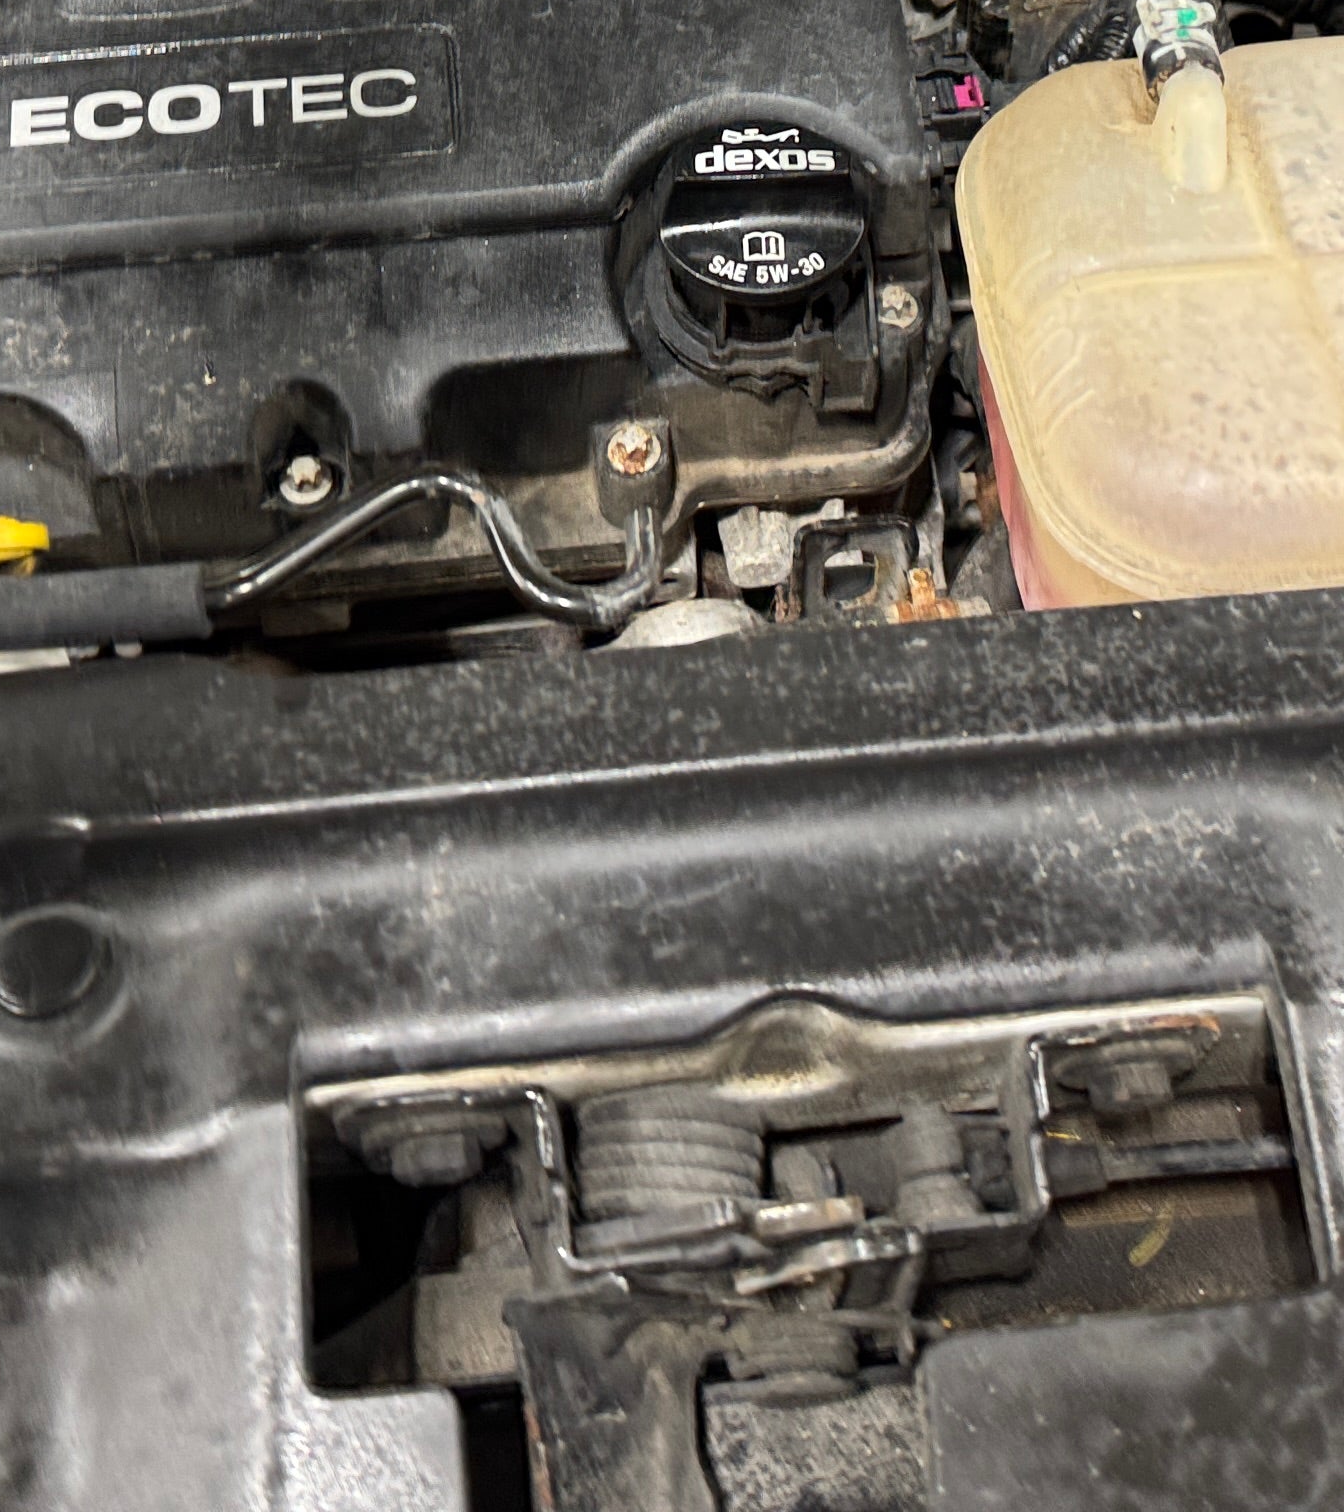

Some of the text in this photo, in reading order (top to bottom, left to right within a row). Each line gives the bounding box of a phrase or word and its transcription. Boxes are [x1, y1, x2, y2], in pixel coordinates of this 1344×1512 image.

[9, 68, 418, 148] ECOTEC
[694, 144, 836, 175] dexos
[708, 252, 826, 285] SAE 5W-30
